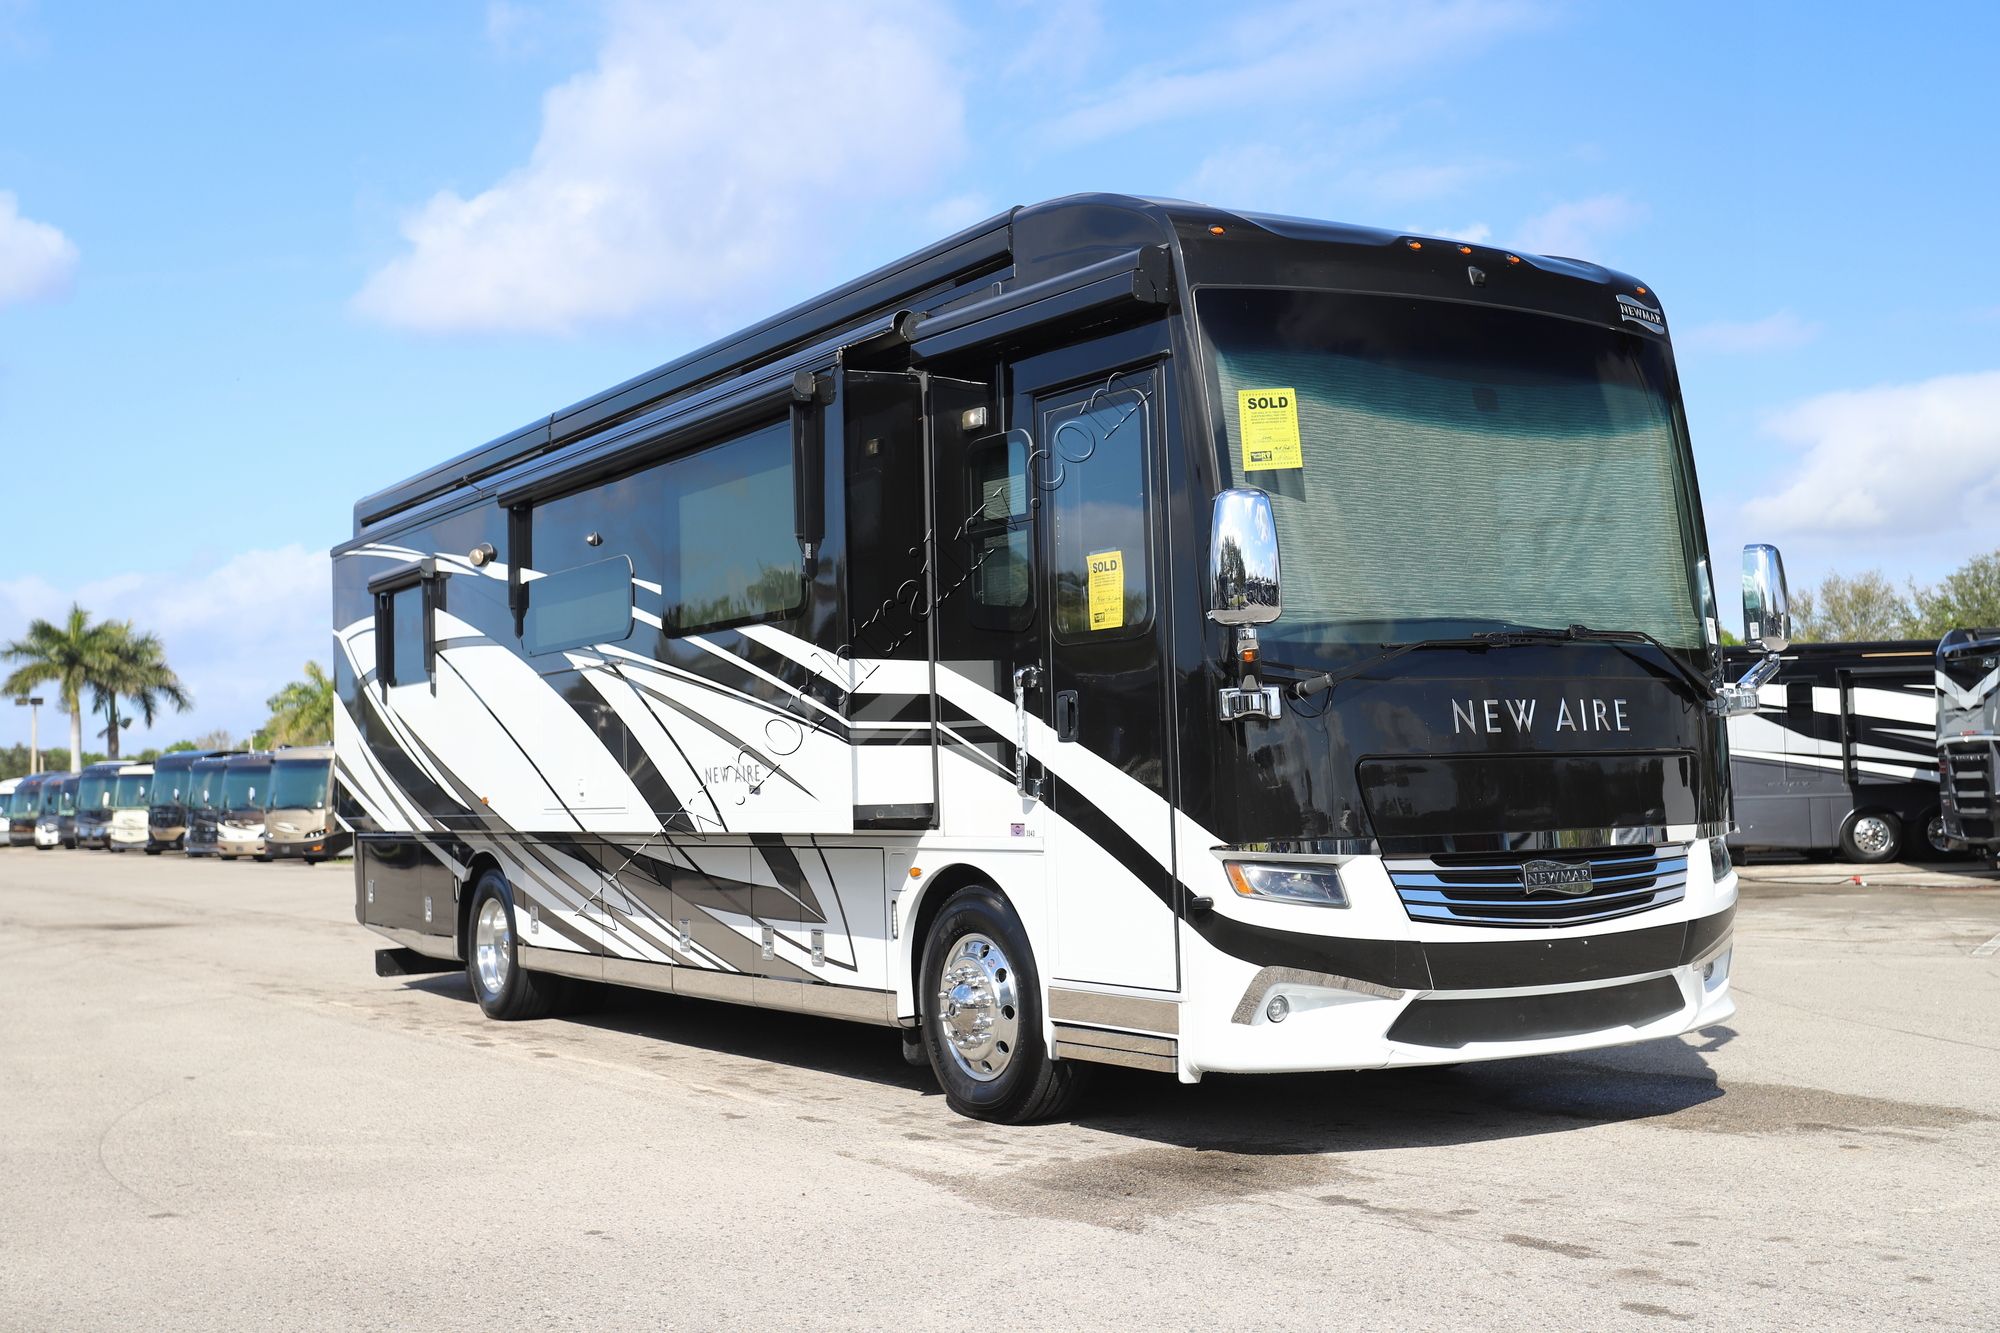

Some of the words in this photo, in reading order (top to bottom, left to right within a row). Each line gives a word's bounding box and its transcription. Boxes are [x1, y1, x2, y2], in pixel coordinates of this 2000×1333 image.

[1620, 304, 1662, 325] NEWMAR
[1248, 397, 1288, 409] SOLD
[1093, 560, 1117, 573] SOLD
[1451, 698, 1536, 735] NEW
[1556, 697, 1630, 732] AIRE
[705, 767, 729, 784] NEW
[735, 765, 760, 783] AIRE
[1528, 870, 1591, 885] NEWMAR
